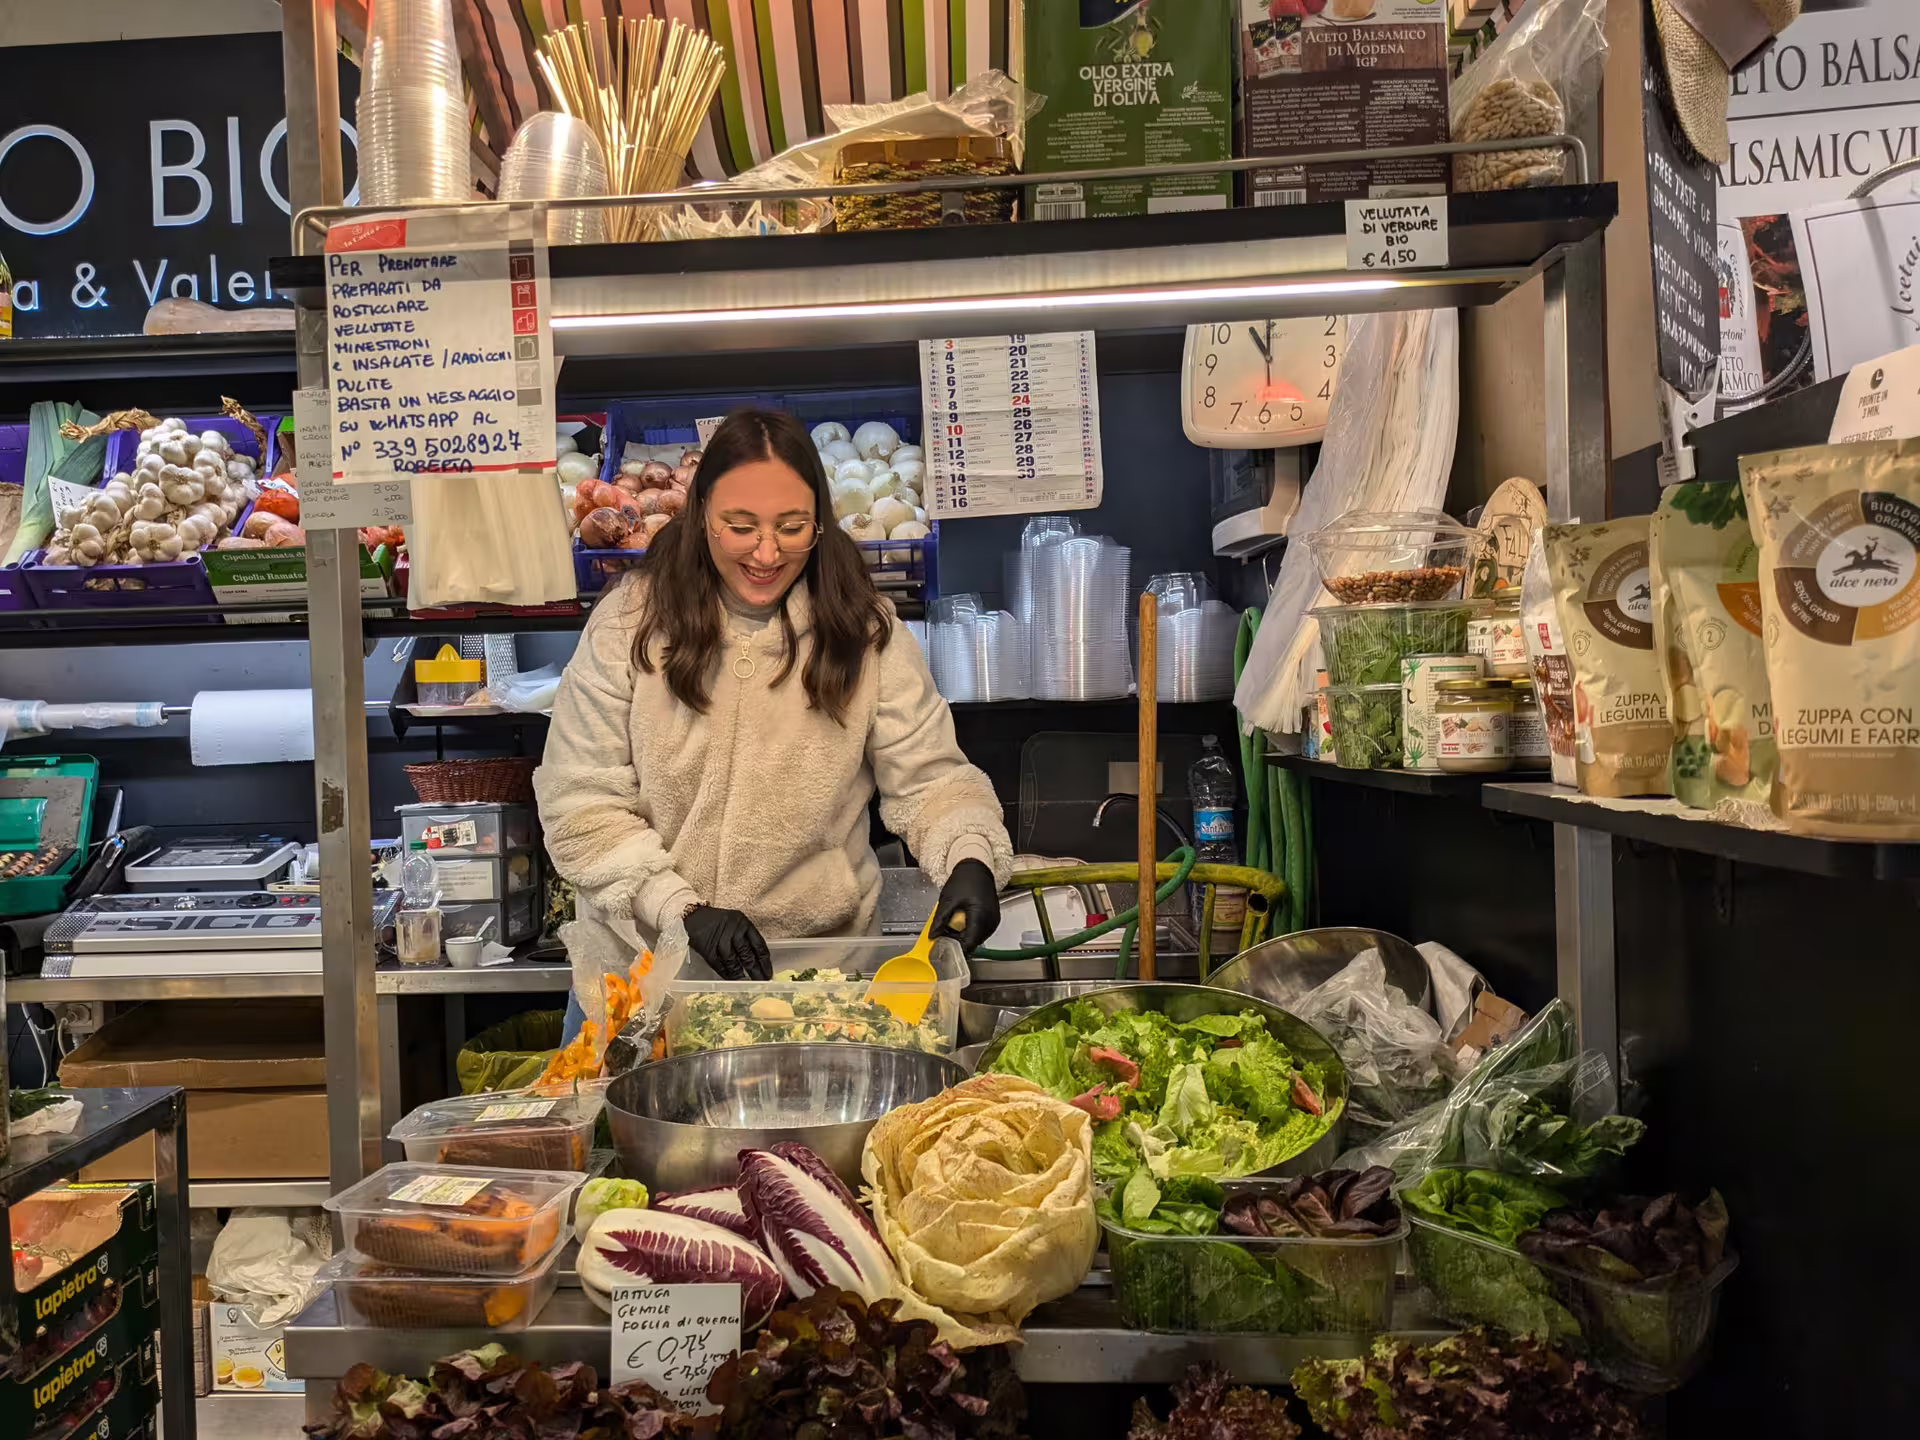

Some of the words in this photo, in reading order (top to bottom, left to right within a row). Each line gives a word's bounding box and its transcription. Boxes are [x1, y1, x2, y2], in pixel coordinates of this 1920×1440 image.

[1305, 30, 1348, 43] ACETO
[1352, 28, 1426, 42] BALSAMICO
[1328, 44, 1343, 56] DI
[1346, 42, 1404, 56] MODENA
[1356, 57, 1378, 67] IGP
[1079, 65, 1117, 80] OLIO
[1122, 62, 1174, 78] EXTRA
[1093, 77, 1157, 93] VERGINE
[1093, 94, 1107, 107] DI
[1112, 91, 1161, 106] OLIVA
[1654, 152, 1673, 189] FREE
[1674, 173, 1697, 214] TASTE
[1359, 205, 1430, 220] VELLUTATA
[1362, 222, 1376, 234] DI
[1381, 219, 1438, 234] VERDURE
[1385, 234, 1409, 247] BIO
[329, 254, 362, 277] PER
[378, 254, 458, 273] PRENOTARE
[1361, 253, 1375, 267] €
[1380, 249, 1417, 266] 4,50
[71, 262, 109, 308] &
[332, 280, 411, 299] PREPARATI
[422, 279, 442, 292] DA
[333, 300, 430, 319] ROSTICCIARE
[334, 320, 416, 337] VELLUTATE
[1324, 314, 1337, 336] 2
[1210, 323, 1231, 346] 10
[334, 338, 431, 355] MINESTRONI
[945, 340, 954, 349] 3
[1009, 345, 1027, 356] 20
[352, 353, 435, 371] INSALATE
[945, 351, 954, 361] 4
[1010, 358, 1026, 369] 21
[1323, 344, 1336, 368] 3
[946, 364, 955, 374] 5
[1205, 353, 1218, 376] 9
[946, 376, 956, 386] 6
[1010, 370, 1029, 381] 22
[337, 378, 393, 392] PULITE
[1011, 382, 1030, 393] 23
[1316, 379, 1331, 401] 4
[337, 393, 392, 413] BASTA
[399, 394, 421, 408] UN
[427, 389, 516, 406] MESSAGGIO
[947, 388, 956, 399] 7
[1012, 394, 1031, 406] 24
[1204, 385, 1216, 408] 8
[1858, 390, 1881, 409] PRONTE
[1881, 389, 1889, 401] IN
[948, 401, 958, 411] 8
[1013, 407, 1032, 418] 25
[1230, 402, 1243, 425] 7
[1258, 402, 1272, 425] 6
[1290, 403, 1303, 422] 5
[472, 411, 499, 426] AL
[949, 412, 959, 423] 9
[1013, 419, 1032, 430] 26
[946, 424, 963, 436] 10
[1014, 431, 1032, 443] 27
[1872, 425, 1893, 442] SOUPS
[373, 436, 418, 460] 339
[424, 429, 523, 458] 5028927
[947, 437, 962, 448] 11
[1015, 444, 1034, 455] 28
[948, 449, 965, 460] 12
[1016, 456, 1035, 467] 29
[393, 458, 474, 474] ROBERTA
[950, 473, 966, 483] 14
[950, 485, 967, 496] 15
[951, 497, 968, 508] 16
[222, 553, 257, 562] Cipolla
[257, 551, 293, 560] Ramata
[232, 573, 265, 583] Cipolla
[266, 571, 304, 581] Ramata
[1829, 575, 1860, 589] alce
[1863, 576, 1898, 588] nero
[1627, 600, 1649, 612] alce
[1793, 579, 1811, 606] SENZA
[1809, 604, 1841, 624] GRASSI
[1615, 692, 1661, 708] ZUPPA
[1600, 706, 1654, 724] LEGUMI
[1659, 706, 1667, 719] E
[1797, 708, 1854, 726] ZUPPA
[1860, 707, 1913, 725] CON
[1782, 728, 1844, 745] LEGUMI
[1851, 728, 1861, 745] E
[613, 1288, 670, 1301] LATTUGA
[617, 1303, 671, 1318] GENTILE
[622, 1320, 671, 1333] FOGLIA
